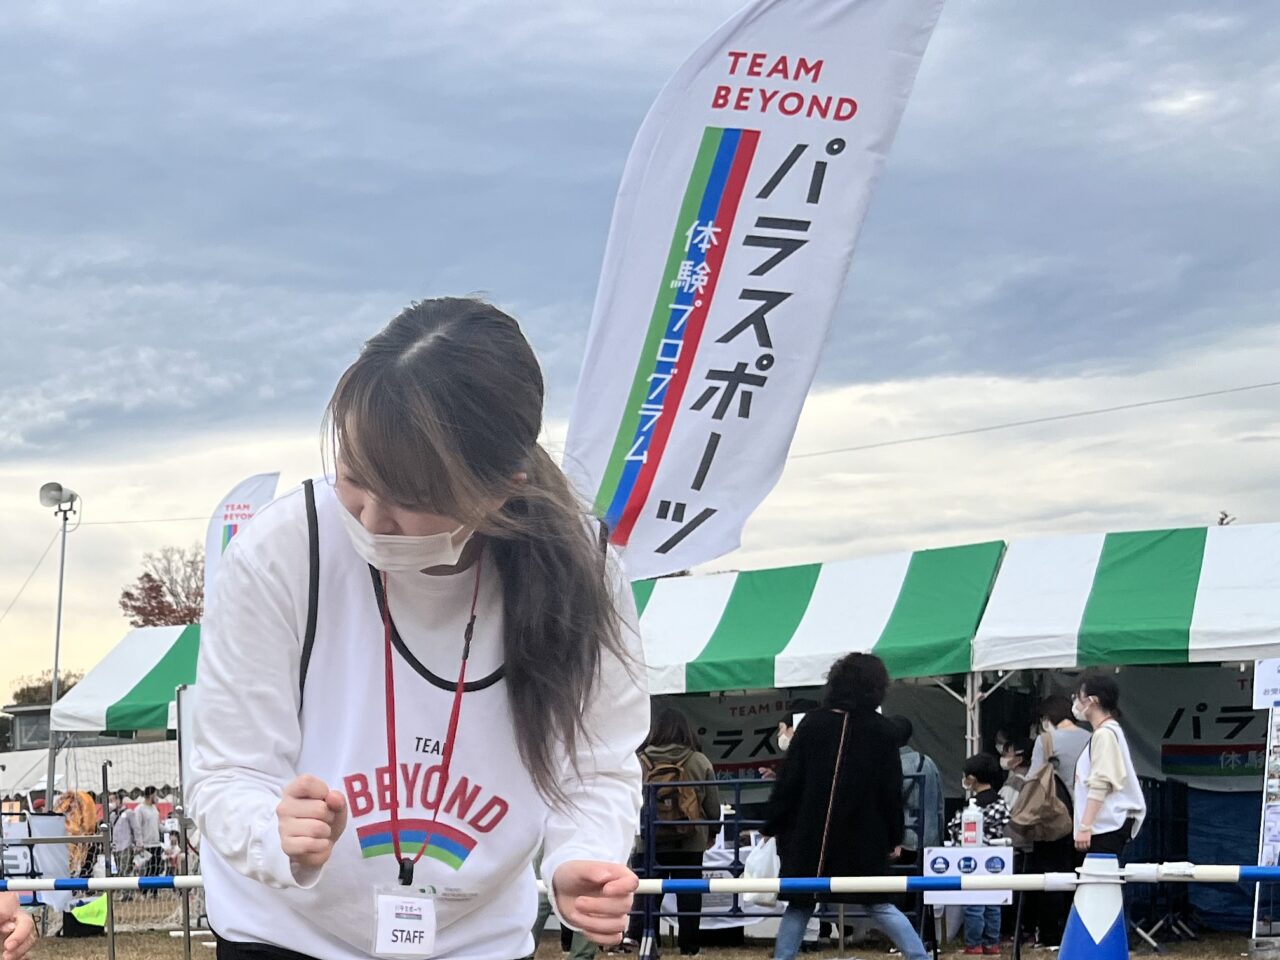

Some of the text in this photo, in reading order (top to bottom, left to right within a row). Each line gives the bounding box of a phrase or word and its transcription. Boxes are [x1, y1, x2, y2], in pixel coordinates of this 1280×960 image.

[726, 51, 824, 84] TEAM
[711, 86, 858, 122] BEYOND
[624, 220, 721, 465] 体験プログラム
[654, 137, 847, 554] パラスポーツ
[224, 504, 251, 512] TEAM
[729, 703, 770, 717] TEAM
[1162, 702, 1267, 740] パラ
[697, 726, 778, 760] ラス
[343, 763, 509, 834] BEYOND
[391, 929, 425, 944] STAFF
